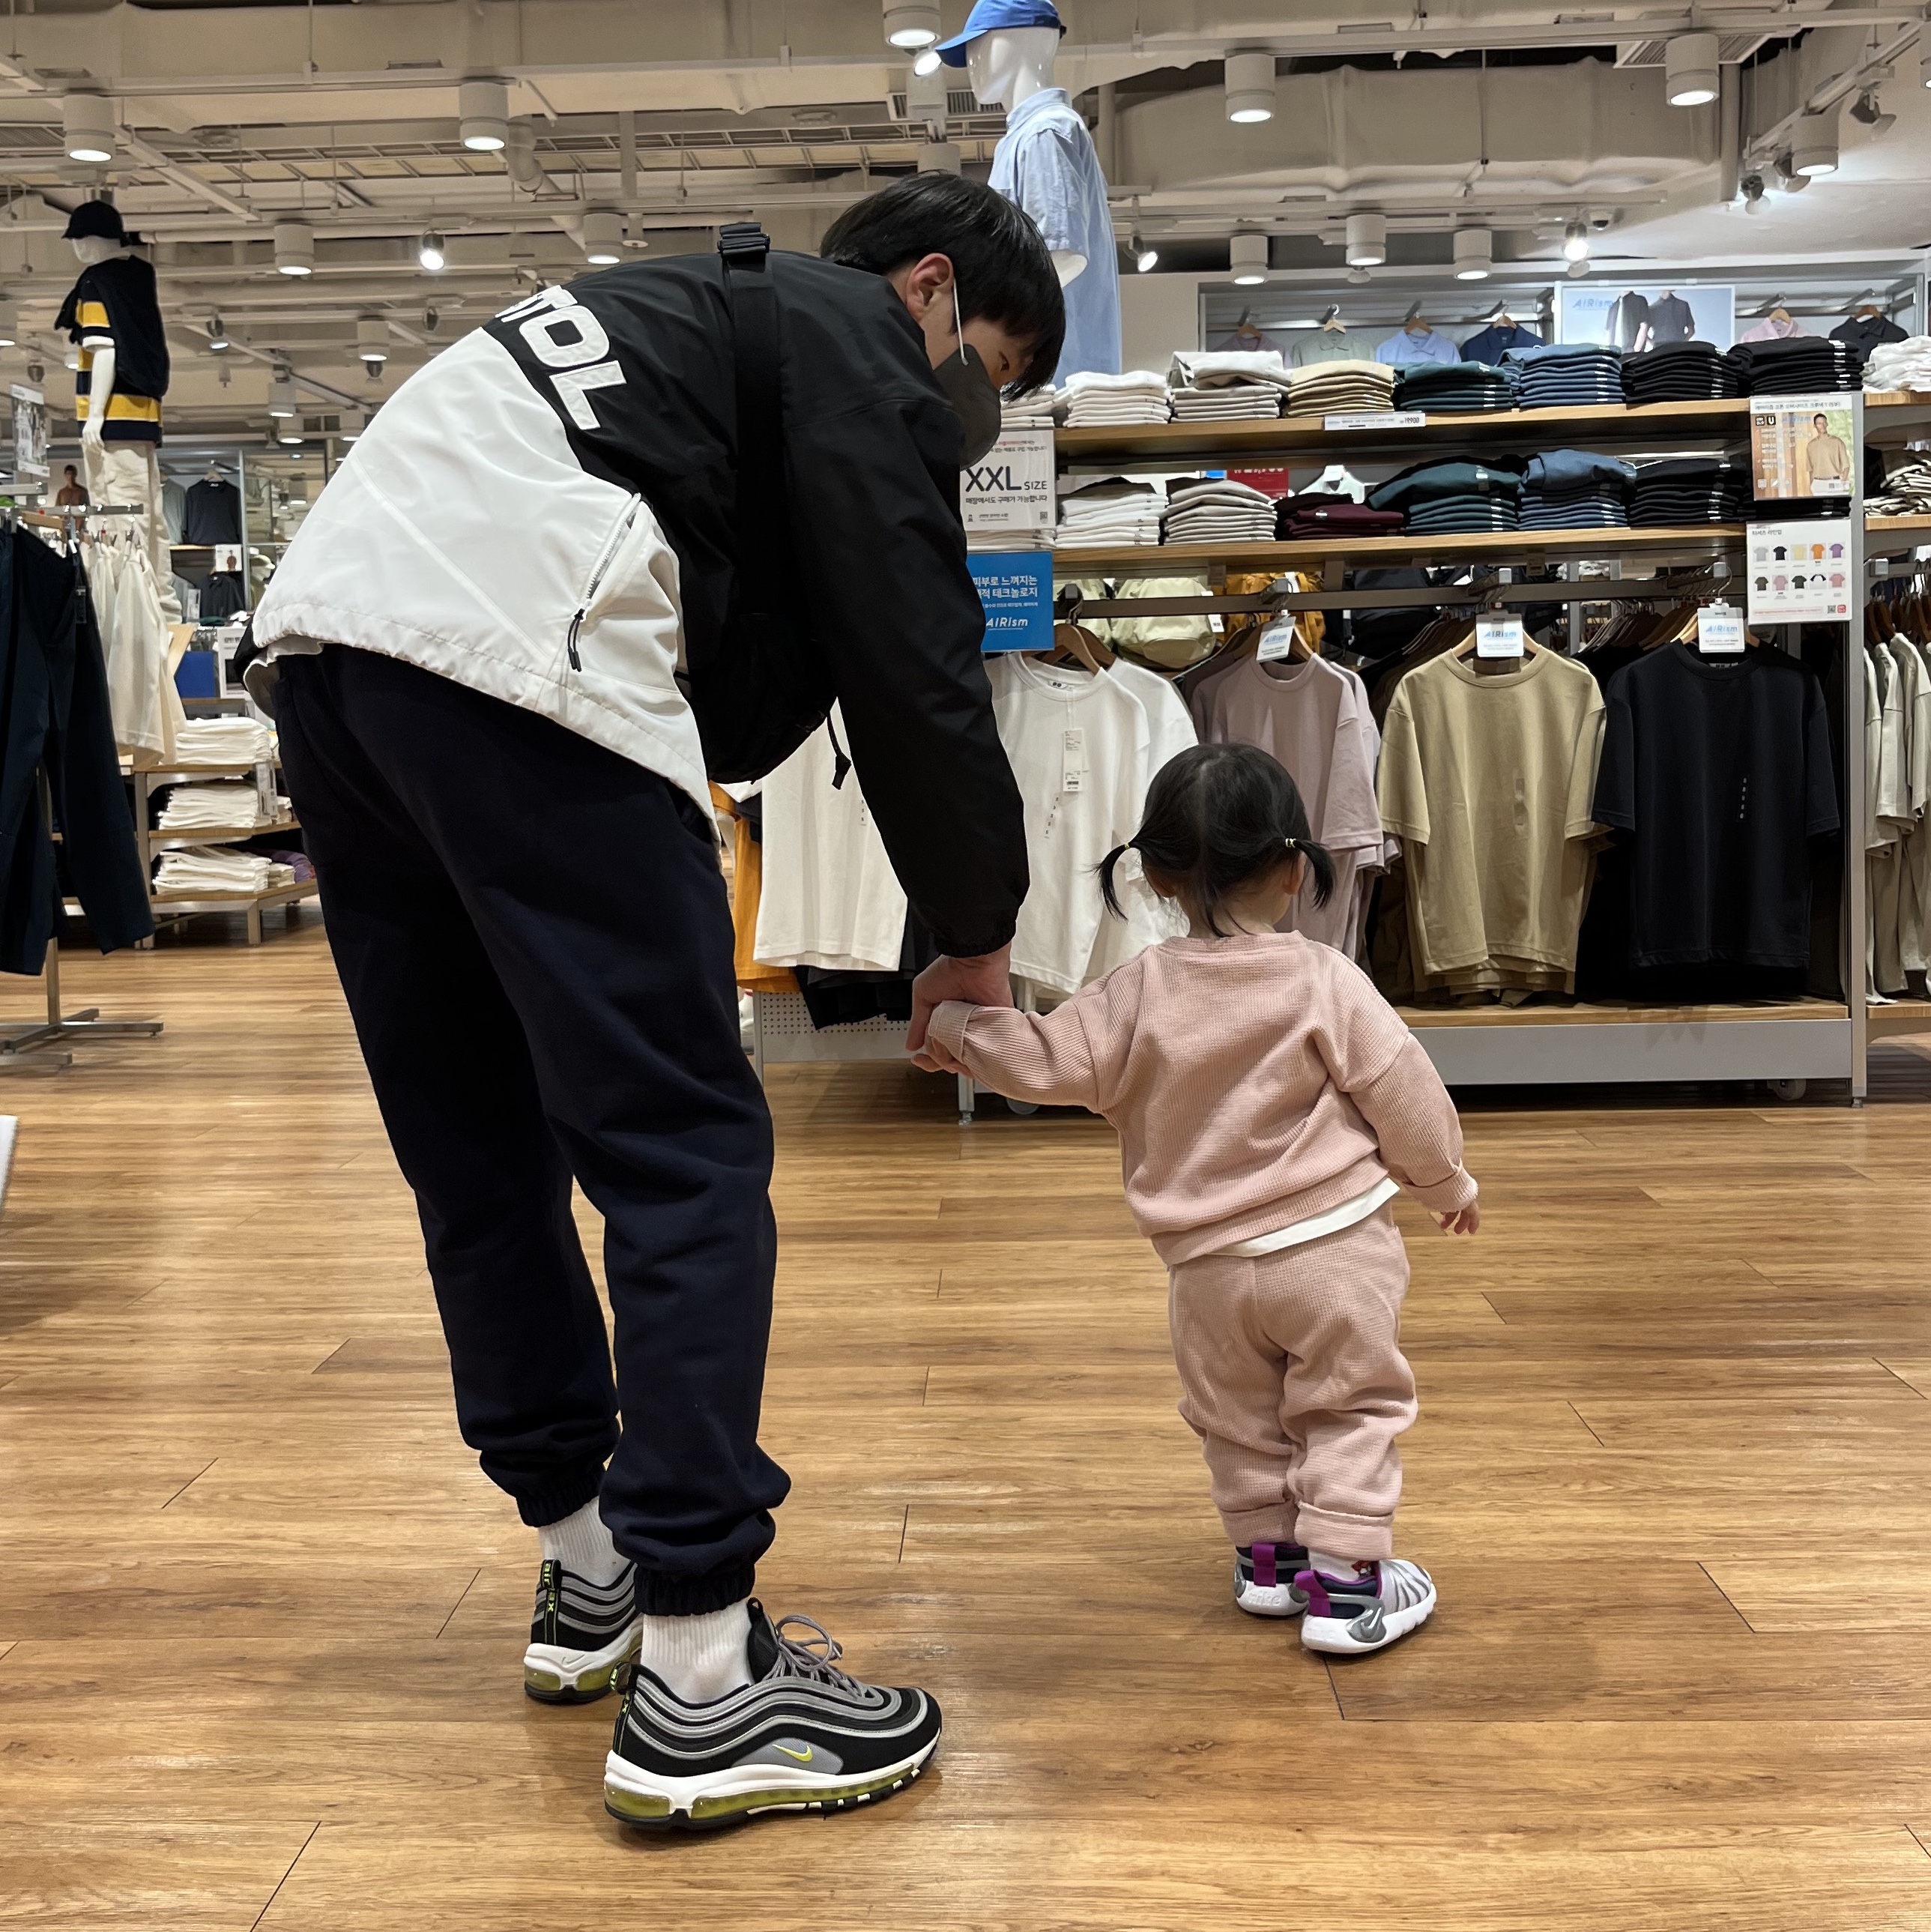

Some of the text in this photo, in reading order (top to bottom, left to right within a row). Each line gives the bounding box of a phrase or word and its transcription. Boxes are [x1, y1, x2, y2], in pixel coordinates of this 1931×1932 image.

[965, 465, 1048, 492] XXL SIZE
[965, 496, 997, 504] 매장에서도
[1017, 495, 1048, 503] 가능합니다
[973, 575, 1038, 587] 피부로 느껴지는
[992, 587, 1038, 599] 테크놀로지
[985, 617, 1028, 628] AIRism
